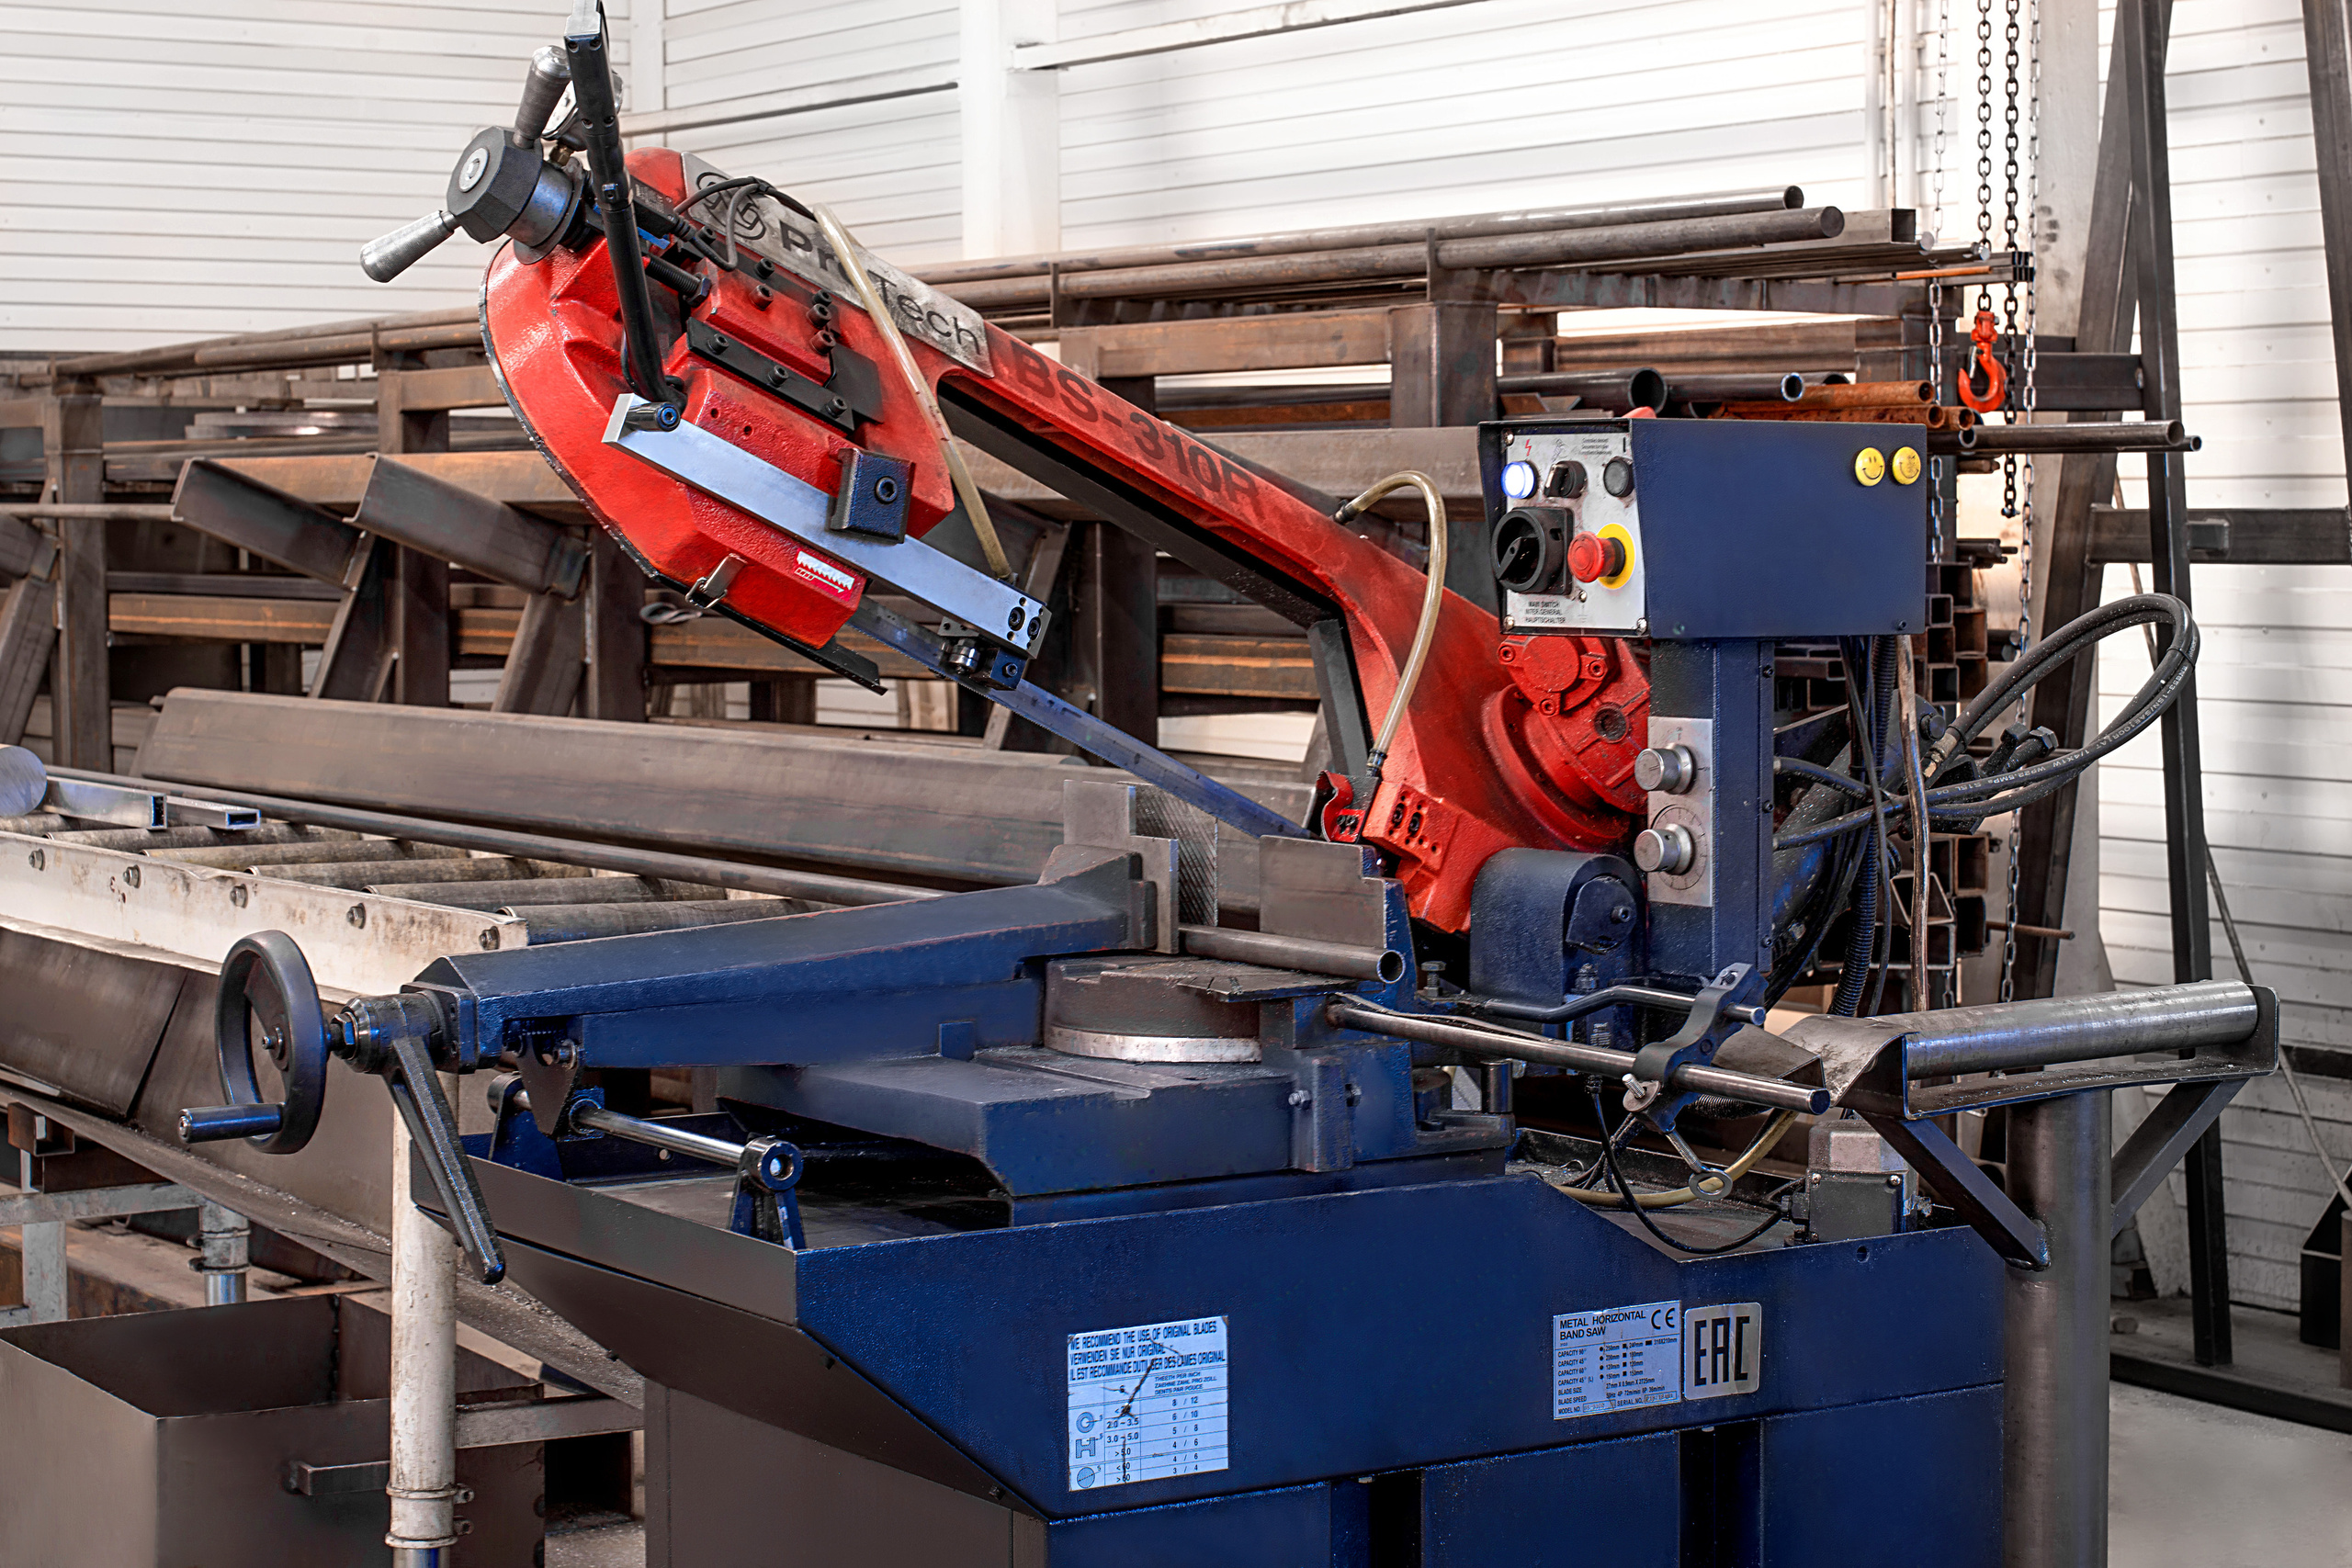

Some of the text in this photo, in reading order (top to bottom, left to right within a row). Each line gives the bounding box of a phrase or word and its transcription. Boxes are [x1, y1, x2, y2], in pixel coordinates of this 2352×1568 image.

[1010, 339, 1265, 525] BS-310R
[1559, 1307, 1675, 1330] METAL HORIZONTAL CE
[1082, 1332, 1120, 1349] RECOMMEND
[1124, 1330, 1136, 1344] THE
[1138, 1328, 1150, 1342] USE
[1152, 1327, 1160, 1340] OF
[1163, 1325, 1192, 1339] ORIGINAL
[1193, 1320, 1217, 1336] BLADES
[1559, 1325, 1607, 1341] BAND SAW
[1110, 1348, 1120, 1361] SIE
[1123, 1345, 1136, 1359] NUR
[1557, 1348, 1578, 1358] CAPACITY
[1694, 1315, 1750, 1387] EAC
[1198, 1350, 1226, 1365] ORIGINAL
[1557, 1359, 1578, 1367] CAPACITY
[1557, 1368, 1578, 1377] CAPACITY
[1557, 1378, 1578, 1386] CAPACITY
[1191, 1396, 1198, 1404] 12
[1557, 1397, 1572, 1405] BLADE
[1573, 1395, 1587, 1404] SPEED
[1558, 1406, 1572, 1415] MODEL
[1617, 1398, 1634, 1407] SERIAL
[1191, 1410, 1198, 1418] 10
[1126, 1417, 1139, 1427] 3.5
[1106, 1435, 1118, 1443] 3.0
[1126, 1432, 1139, 1441] 5.0
